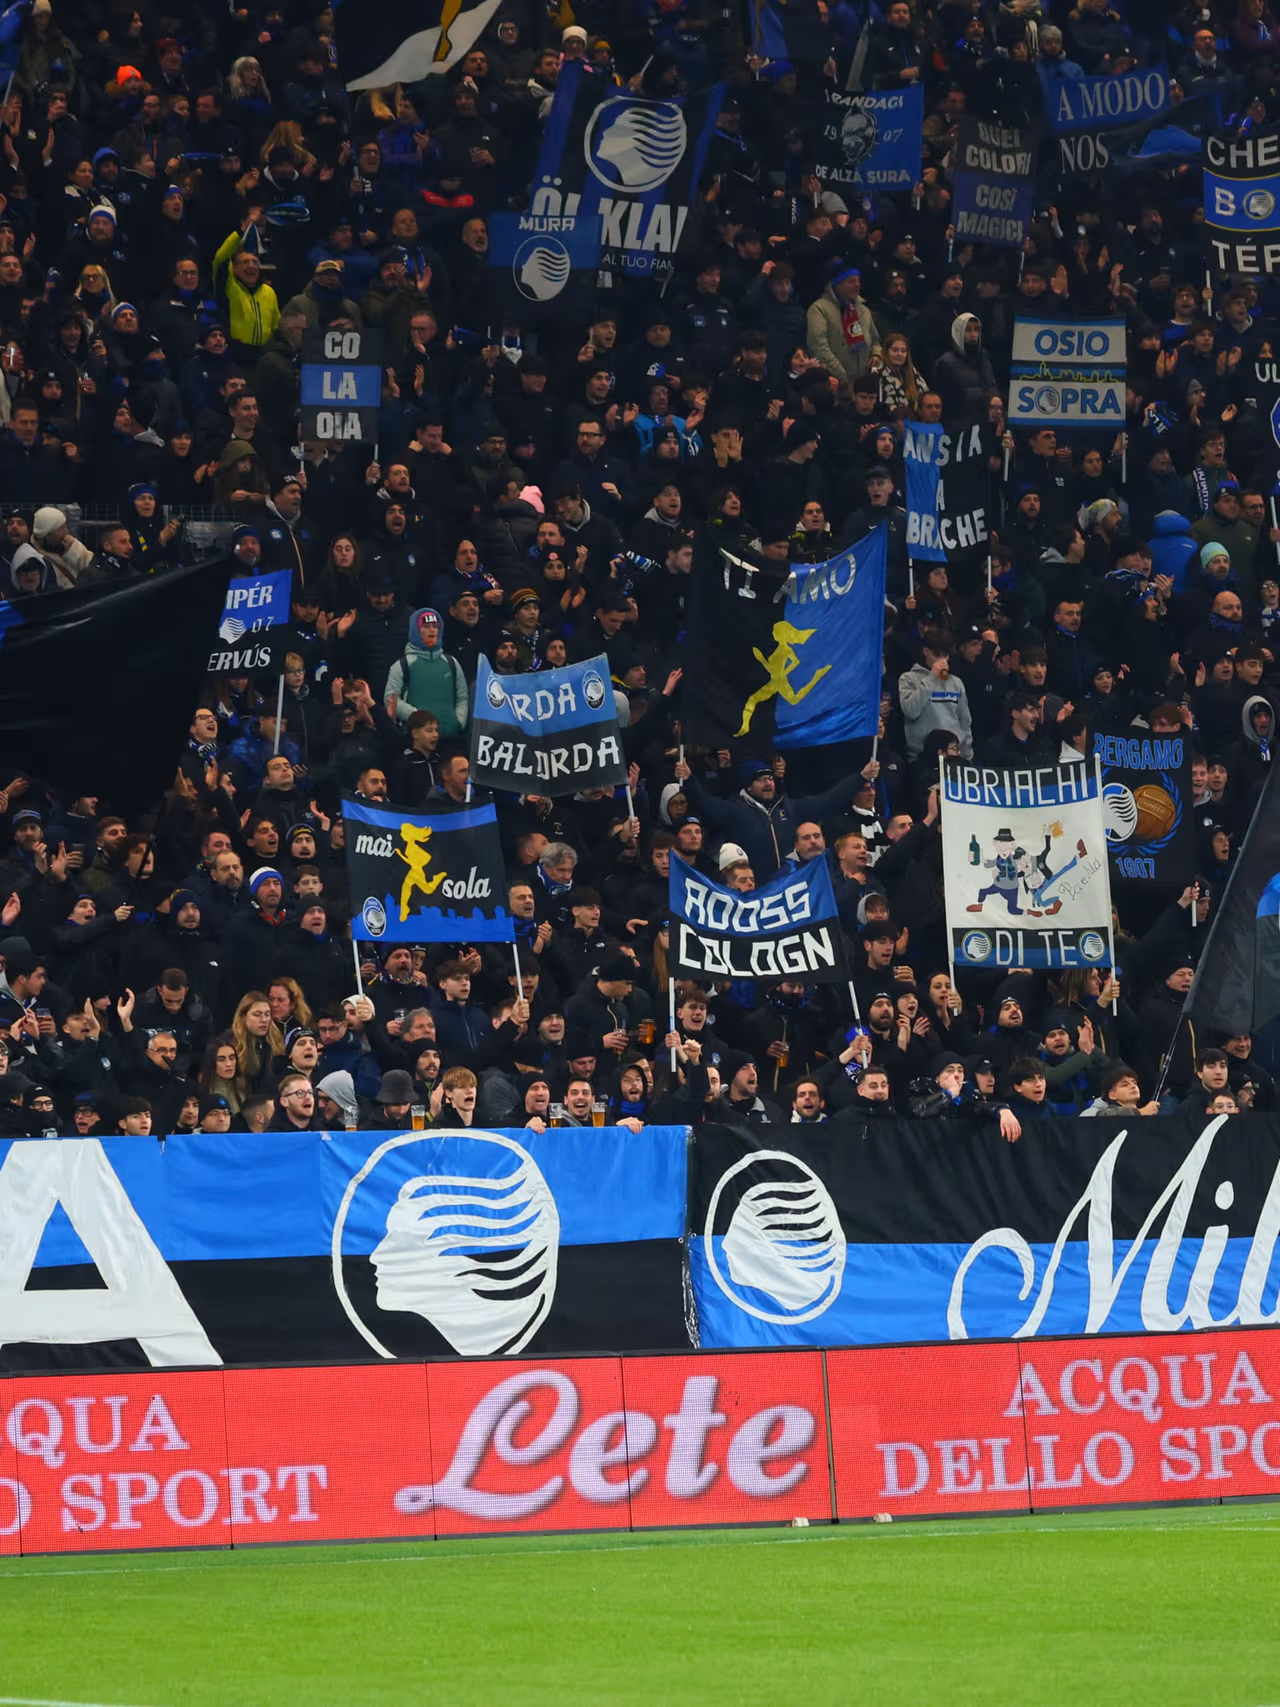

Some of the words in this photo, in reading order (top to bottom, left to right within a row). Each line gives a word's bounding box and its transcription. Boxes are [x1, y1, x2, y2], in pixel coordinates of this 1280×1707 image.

[831, 92, 904, 110] RANDAGI
[1058, 85, 1075, 121] A
[1079, 72, 1166, 118] MODO
[824, 124, 837, 140] 19
[883, 128, 904, 143] 07
[965, 144, 1032, 175] COLORI
[1207, 135, 1280, 168] CHE
[815, 164, 829, 179] DE
[866, 169, 912, 184] SURA
[518, 216, 576, 232] MURA
[957, 211, 1024, 242] MAGICI
[602, 253, 616, 266] AL
[620, 255, 648, 269] TUO
[324, 331, 361, 359] CO
[1034, 329, 1110, 357] OSIO
[322, 371, 358, 400] LA
[316, 411, 362, 440] OIA
[903, 424, 983, 466] ANSIA
[935, 479, 946, 512] A
[773, 553, 857, 604] AMO
[1094, 733, 1184, 770] BERGAMO
[947, 762, 1089, 806] UBRIACHI
[355, 833, 396, 858] mai
[441, 866, 492, 900] sola
[1115, 857, 1155, 879] 1907
[995, 930, 1025, 966] DI
[1038, 930, 1078, 966] TE
[1003, 1351, 1273, 1422] ACQUA
[393, 1370, 815, 1520] Lete
[876, 1431, 1135, 1498] DELLO
[60, 1465, 328, 1533] SPORT
